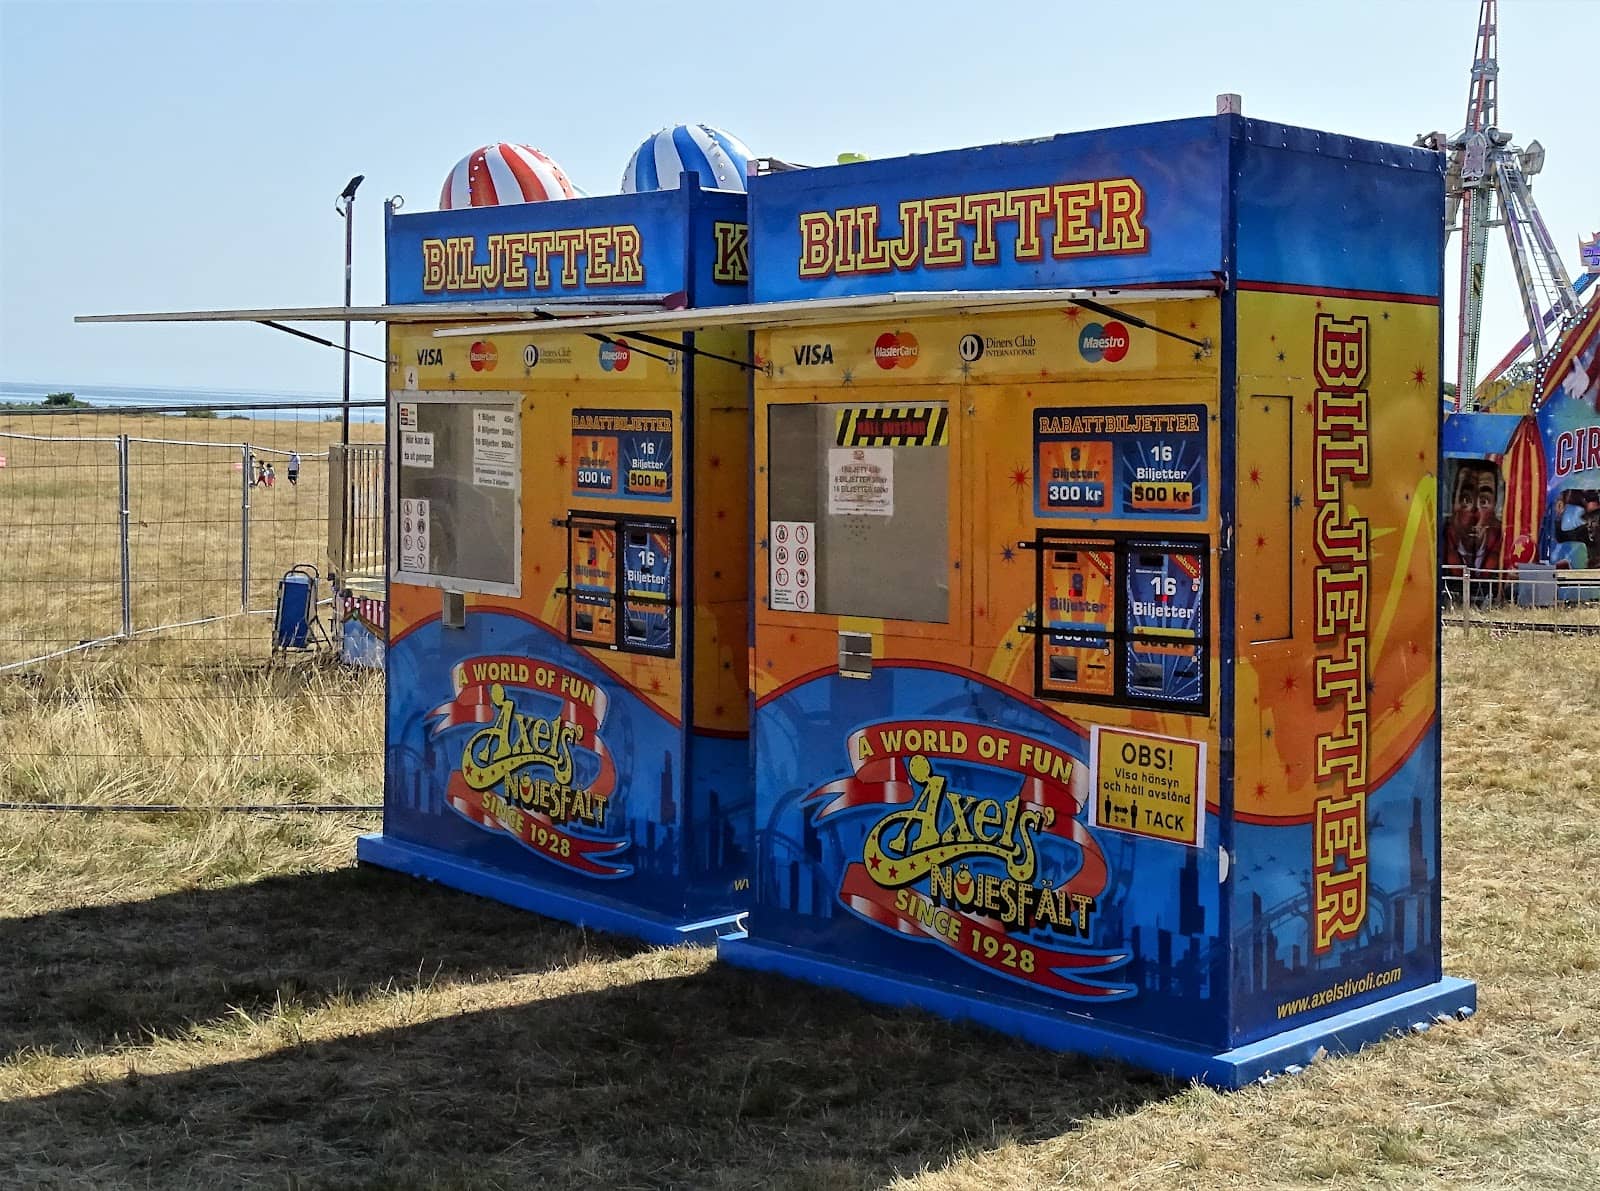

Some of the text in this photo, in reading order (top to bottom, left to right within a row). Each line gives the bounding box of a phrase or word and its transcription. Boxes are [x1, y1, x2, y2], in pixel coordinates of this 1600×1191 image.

[799, 178, 1148, 278] BILJETTER
[423, 224, 644, 292] BILJETTER
[986, 333, 1036, 349] Diners Club
[1083, 333, 1126, 350] Maestro
[417, 348, 443, 366] VISA
[601, 350, 628, 361] Maestro
[794, 344, 835, 366] VISA
[874, 344, 919, 359] MasterCard
[408, 373, 413, 385] 4
[1039, 413, 1200, 434] RABATTBILJETTER
[640, 442, 655, 454] 16
[1151, 446, 1173, 462] 16
[632, 459, 664, 470] Biljetter
[578, 471, 611, 484] 300 kr
[630, 472, 666, 488] 500 kr
[1052, 468, 1099, 481] Biljetter
[1136, 467, 1187, 482] Biljetter
[1049, 486, 1102, 501] 300 kr
[1134, 486, 1190, 502] 500 kr
[638, 550, 655, 566] 16
[627, 569, 666, 585] Biljetter
[1150, 576, 1177, 596] 16
[1049, 597, 1106, 613] Biljetter
[1133, 601, 1194, 618] Biljetter
[1314, 313, 1370, 955] BILJETTER
[458, 662, 595, 707] A WORLD OF FUN
[858, 729, 1074, 785] A WORLD OF FUN
[1122, 742, 1174, 772] OBS!
[1115, 767, 1180, 789] Visa hänsyn
[1104, 780, 1191, 805] och håll avstånd
[481, 791, 571, 857] SINCE 1928
[1145, 809, 1184, 832] TACK
[895, 889, 1036, 974] SINCE 1928
[1277, 967, 1402, 1019] www.axelstivoli.com
